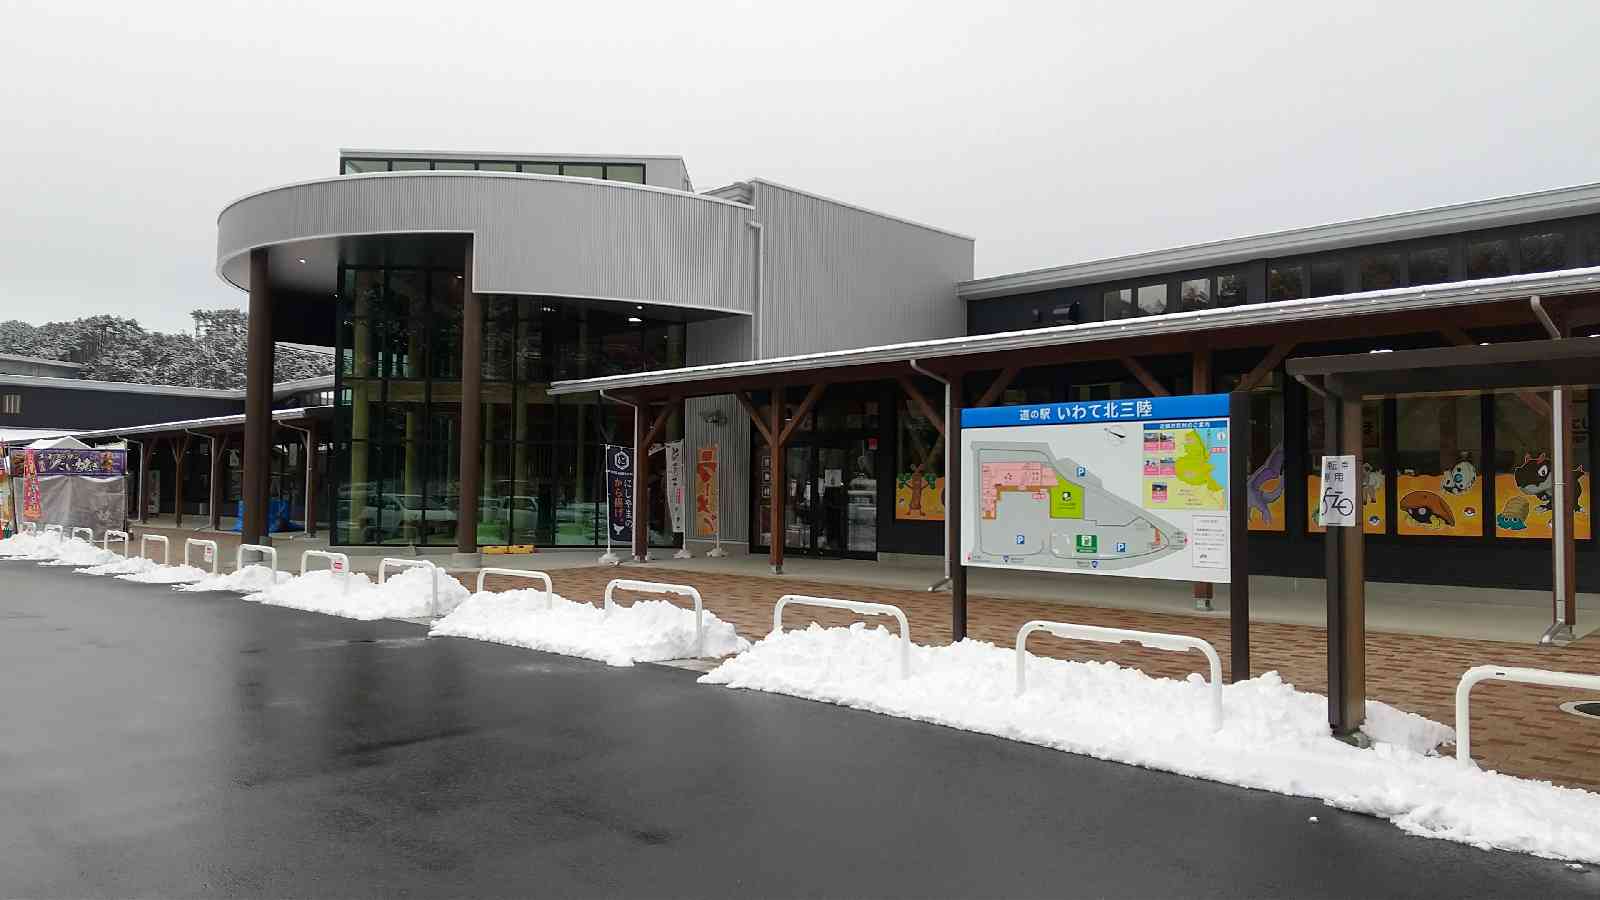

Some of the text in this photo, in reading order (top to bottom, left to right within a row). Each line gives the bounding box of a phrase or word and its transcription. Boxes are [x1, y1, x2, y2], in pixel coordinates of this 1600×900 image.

[1019, 400, 1153, 421] 道の駅 いわて北三陸
